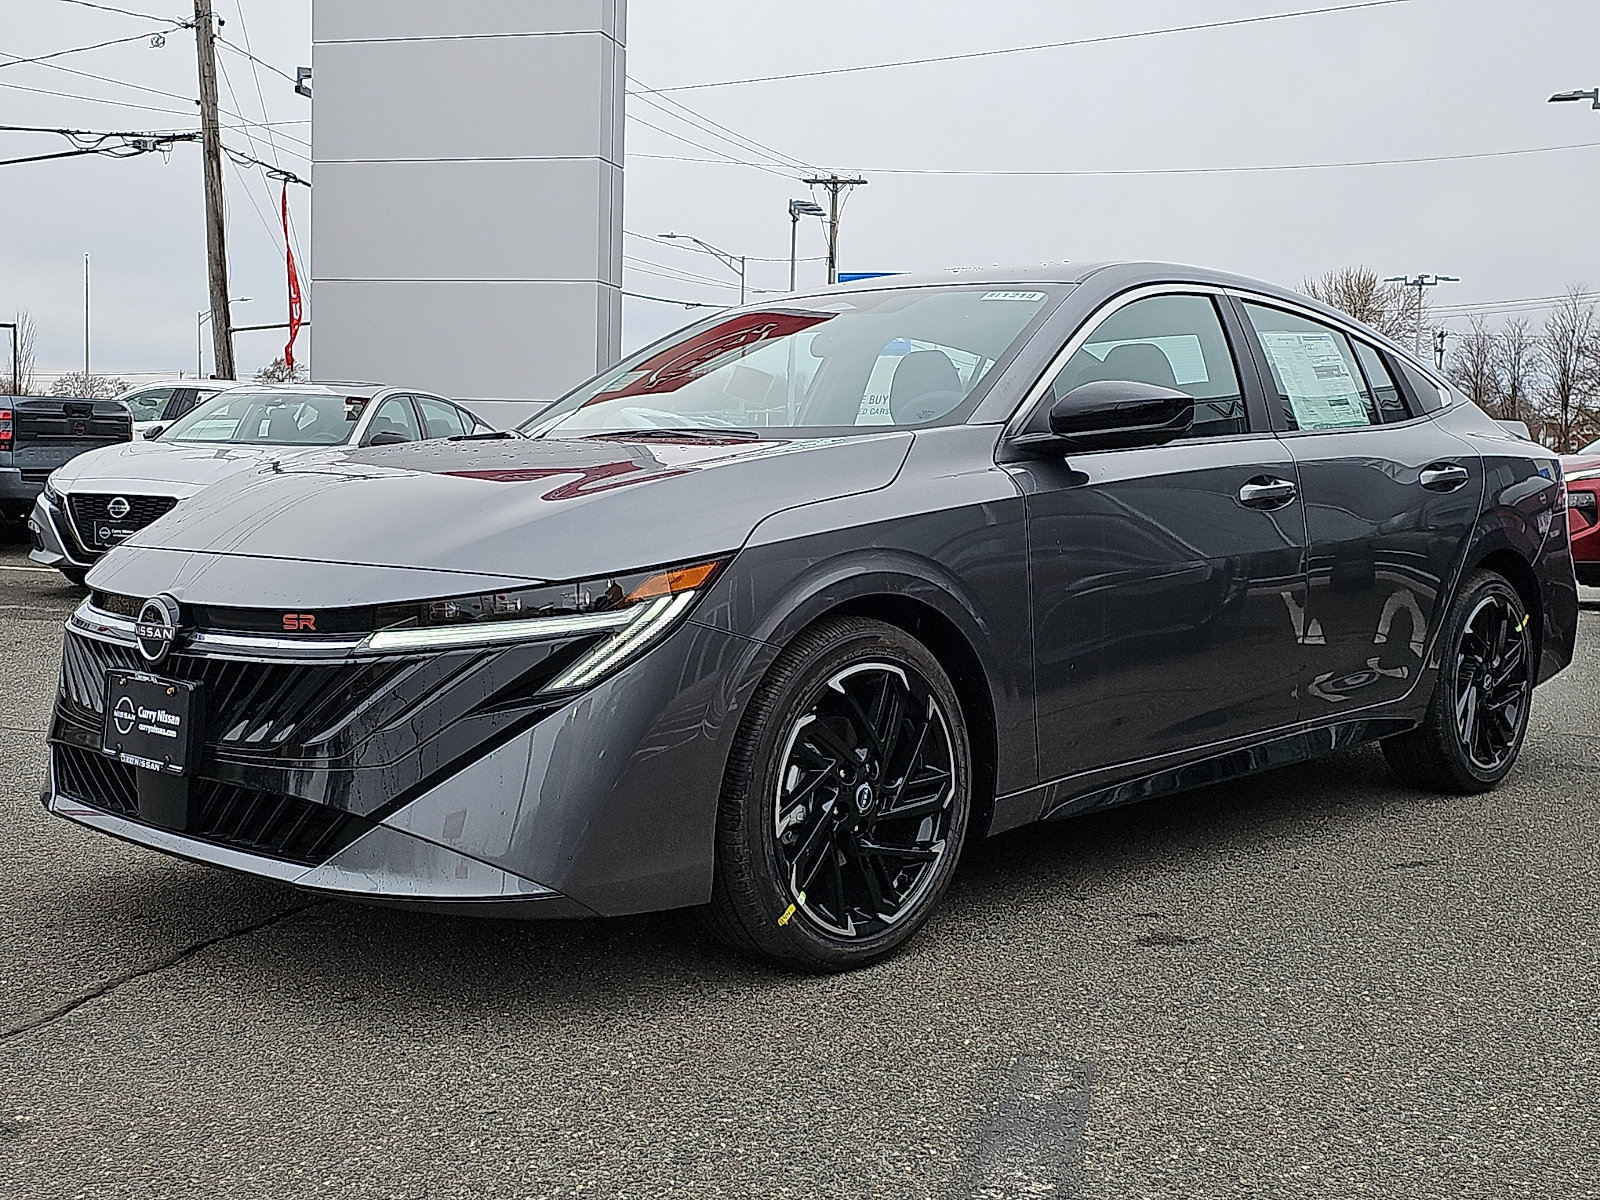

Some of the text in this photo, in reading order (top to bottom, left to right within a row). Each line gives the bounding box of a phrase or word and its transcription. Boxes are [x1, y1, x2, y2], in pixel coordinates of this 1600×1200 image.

[869, 394, 889, 405] BUY
[869, 407, 889, 415] CARS
[282, 613, 317, 631] SR
[113, 709, 136, 721] NISSAN
[138, 706, 181, 726] Curry Nissan
